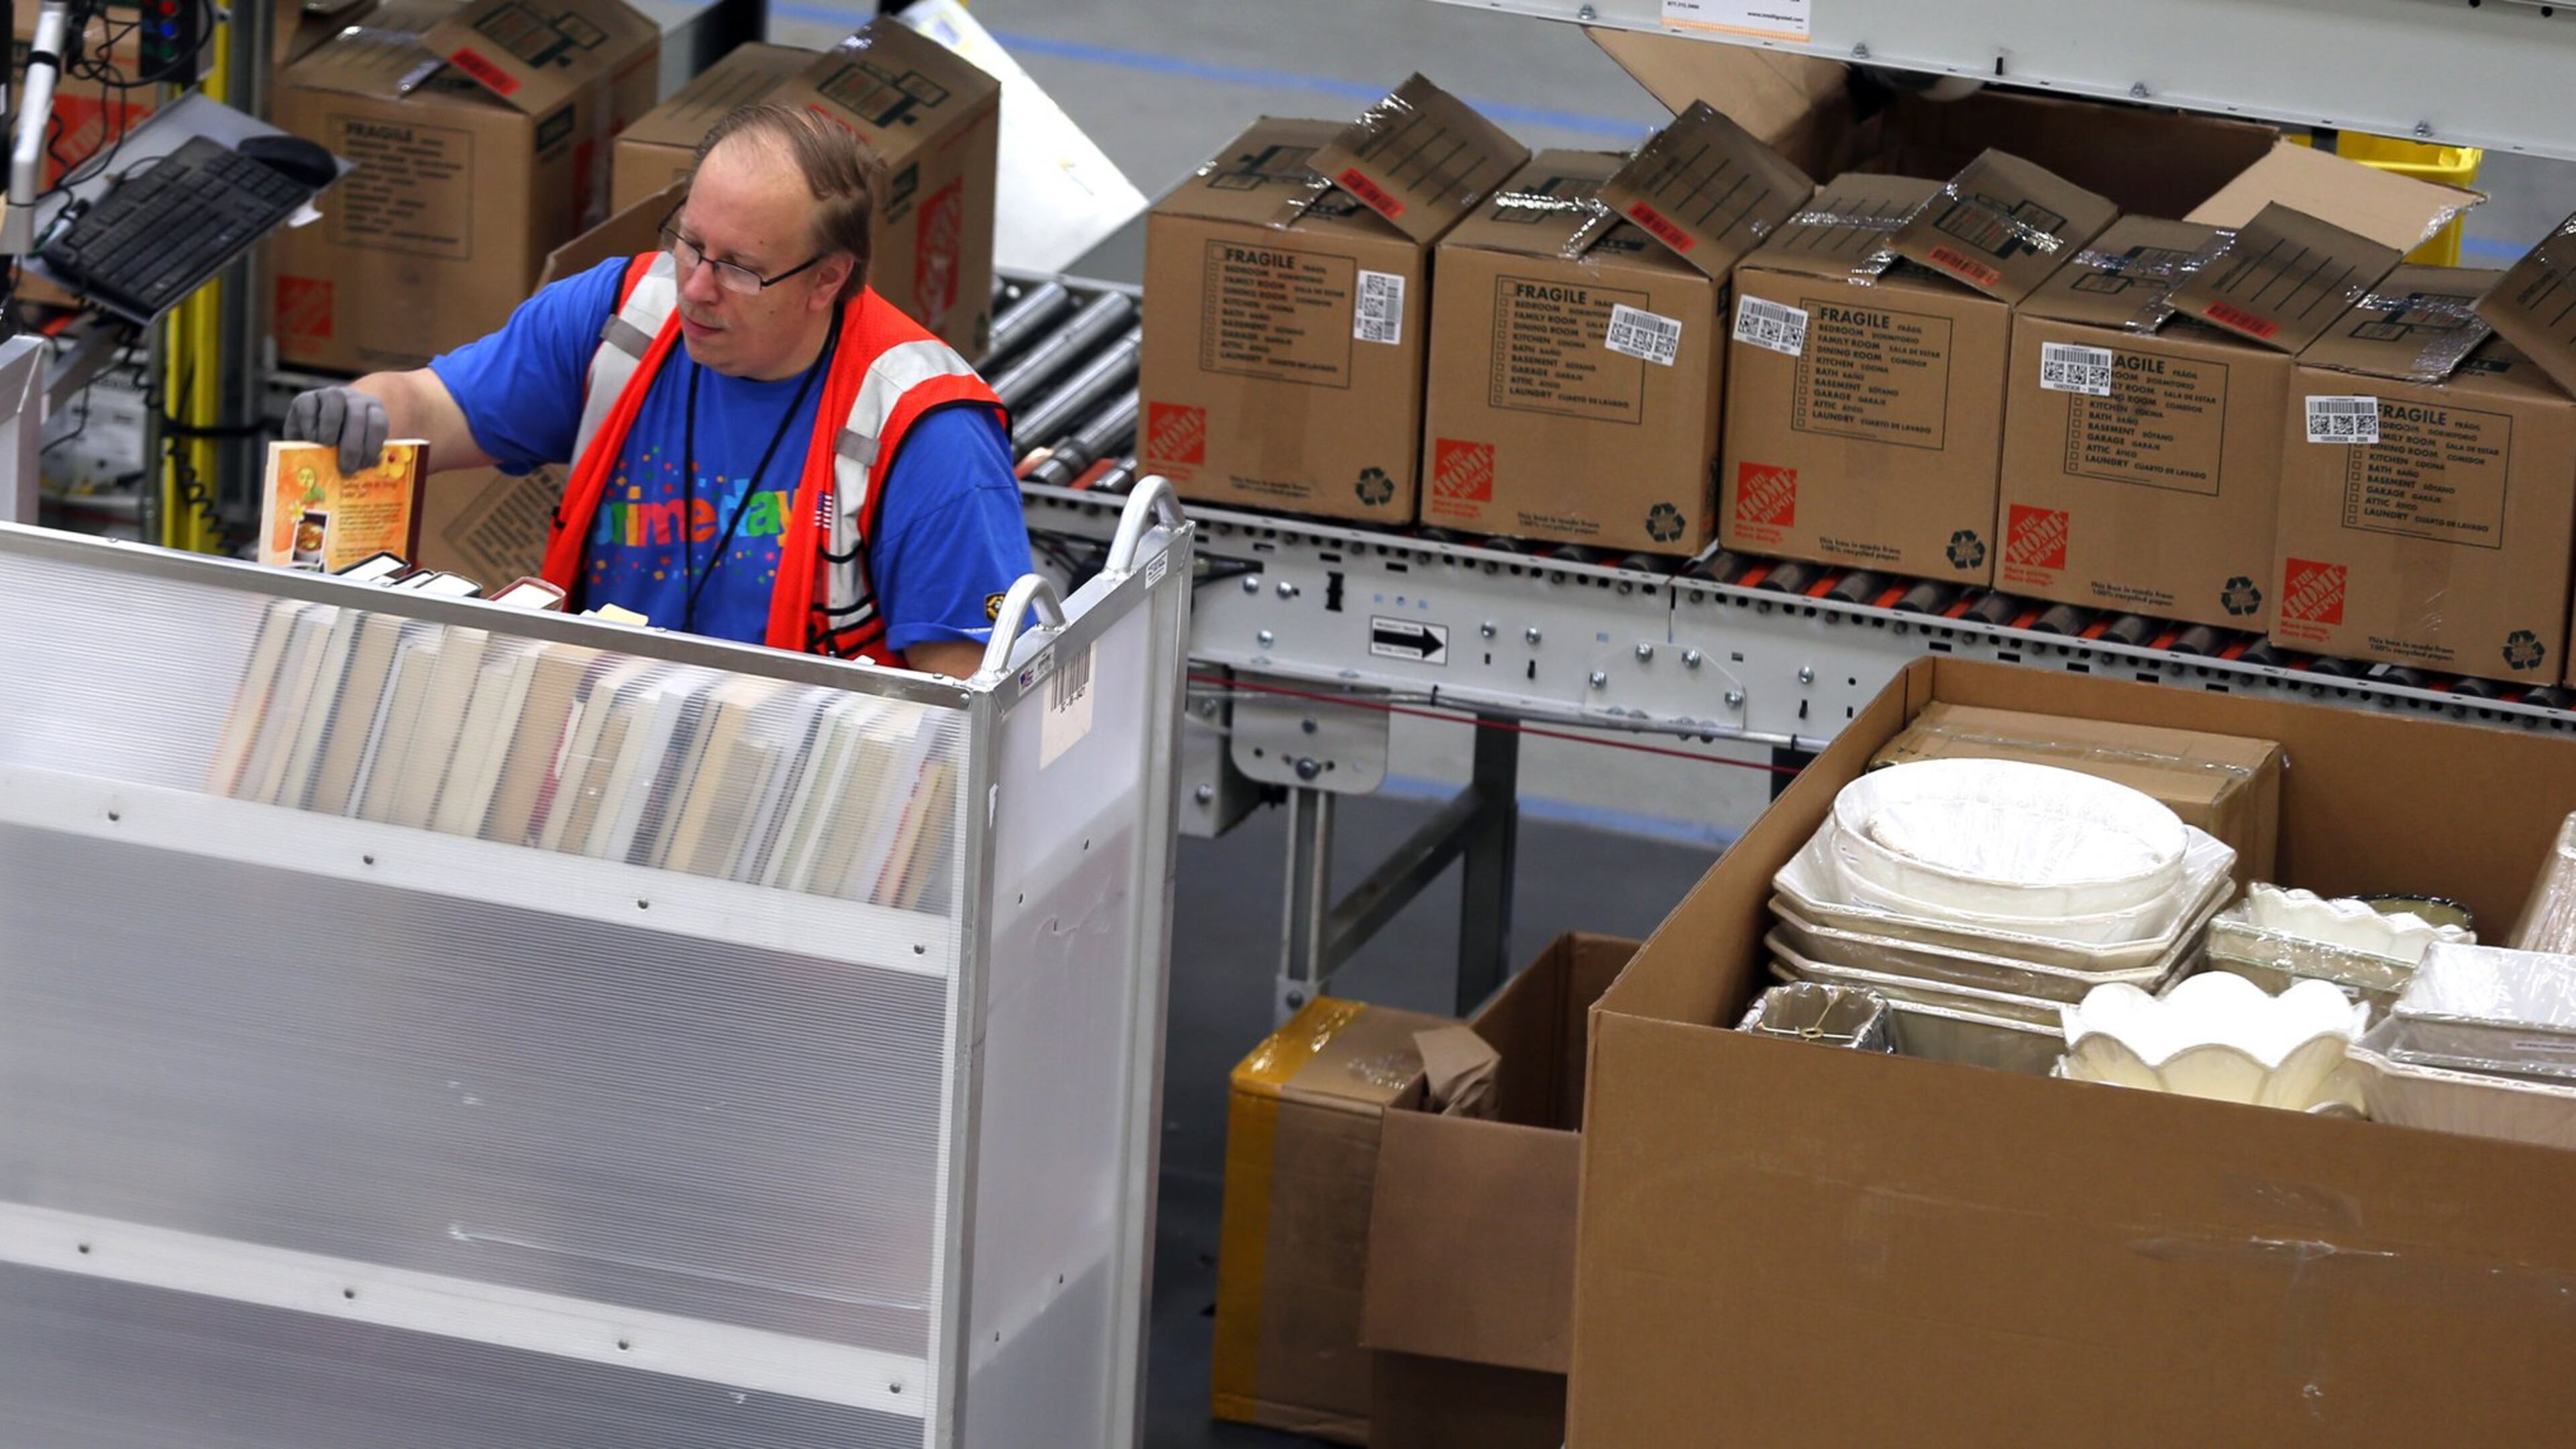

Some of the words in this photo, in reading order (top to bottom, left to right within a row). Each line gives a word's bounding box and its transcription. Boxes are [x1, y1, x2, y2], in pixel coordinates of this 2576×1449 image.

[1226, 248, 1295, 269] FRAGILE
[1516, 283, 1586, 305] FRAGILE
[1819, 307, 1890, 329] FRAGILE
[1818, 323, 1864, 337] BEDROOM
[1817, 335, 1849, 345] FAMILY
[1851, 339, 1880, 350] ROOM
[1817, 345, 1851, 356] DINING
[1853, 350, 1882, 361] ROOM
[1816, 356, 1854, 368] KITCHEN
[1815, 367, 1838, 377] BATH
[1815, 378, 1861, 392] BASEMENT
[2125, 384, 2155, 394] ROOM
[1813, 389, 1851, 401] GARAGE
[2127, 394, 2157, 406] ROOM
[1813, 400, 1837, 410] ATTIC
[2089, 400, 2127, 413] KITCHEN
[1813, 410, 1856, 423] LAUNDRY
[2088, 411, 2112, 421] BATH
[2088, 422, 2135, 436] BASEMENT
[2378, 421, 2420, 433] EDROOM
[2086, 433, 2125, 445] GARAGE
[2377, 432, 2404, 442] AMILY
[2406, 435, 2436, 447] ROOM
[2086, 443, 2110, 453] ATTIC
[2369, 441, 2405, 453] DINING
[2408, 447, 2438, 458] ROOM
[2085, 454, 2129, 468] LAUNDRY
[2369, 453, 2408, 465] KITCHEN
[1434, 445, 1492, 498] HOME
[2367, 464, 2392, 474] BATH
[2367, 474, 2415, 488] BASEMENT
[1737, 469, 1795, 521] HOME
[2365, 486, 2405, 498] GARAGE
[1759, 492, 1795, 524] DEPOT
[2365, 496, 2390, 506] ATTIC
[2363, 507, 2408, 521] LAUNDRY
[2014, 513, 2037, 534] THE
[2008, 511, 2066, 564] HOME
[2031, 535, 2065, 565] DEPOT
[2292, 568, 2316, 588] THE
[2283, 565, 2344, 617] HOME
[2306, 590, 2343, 620] DEPOT
